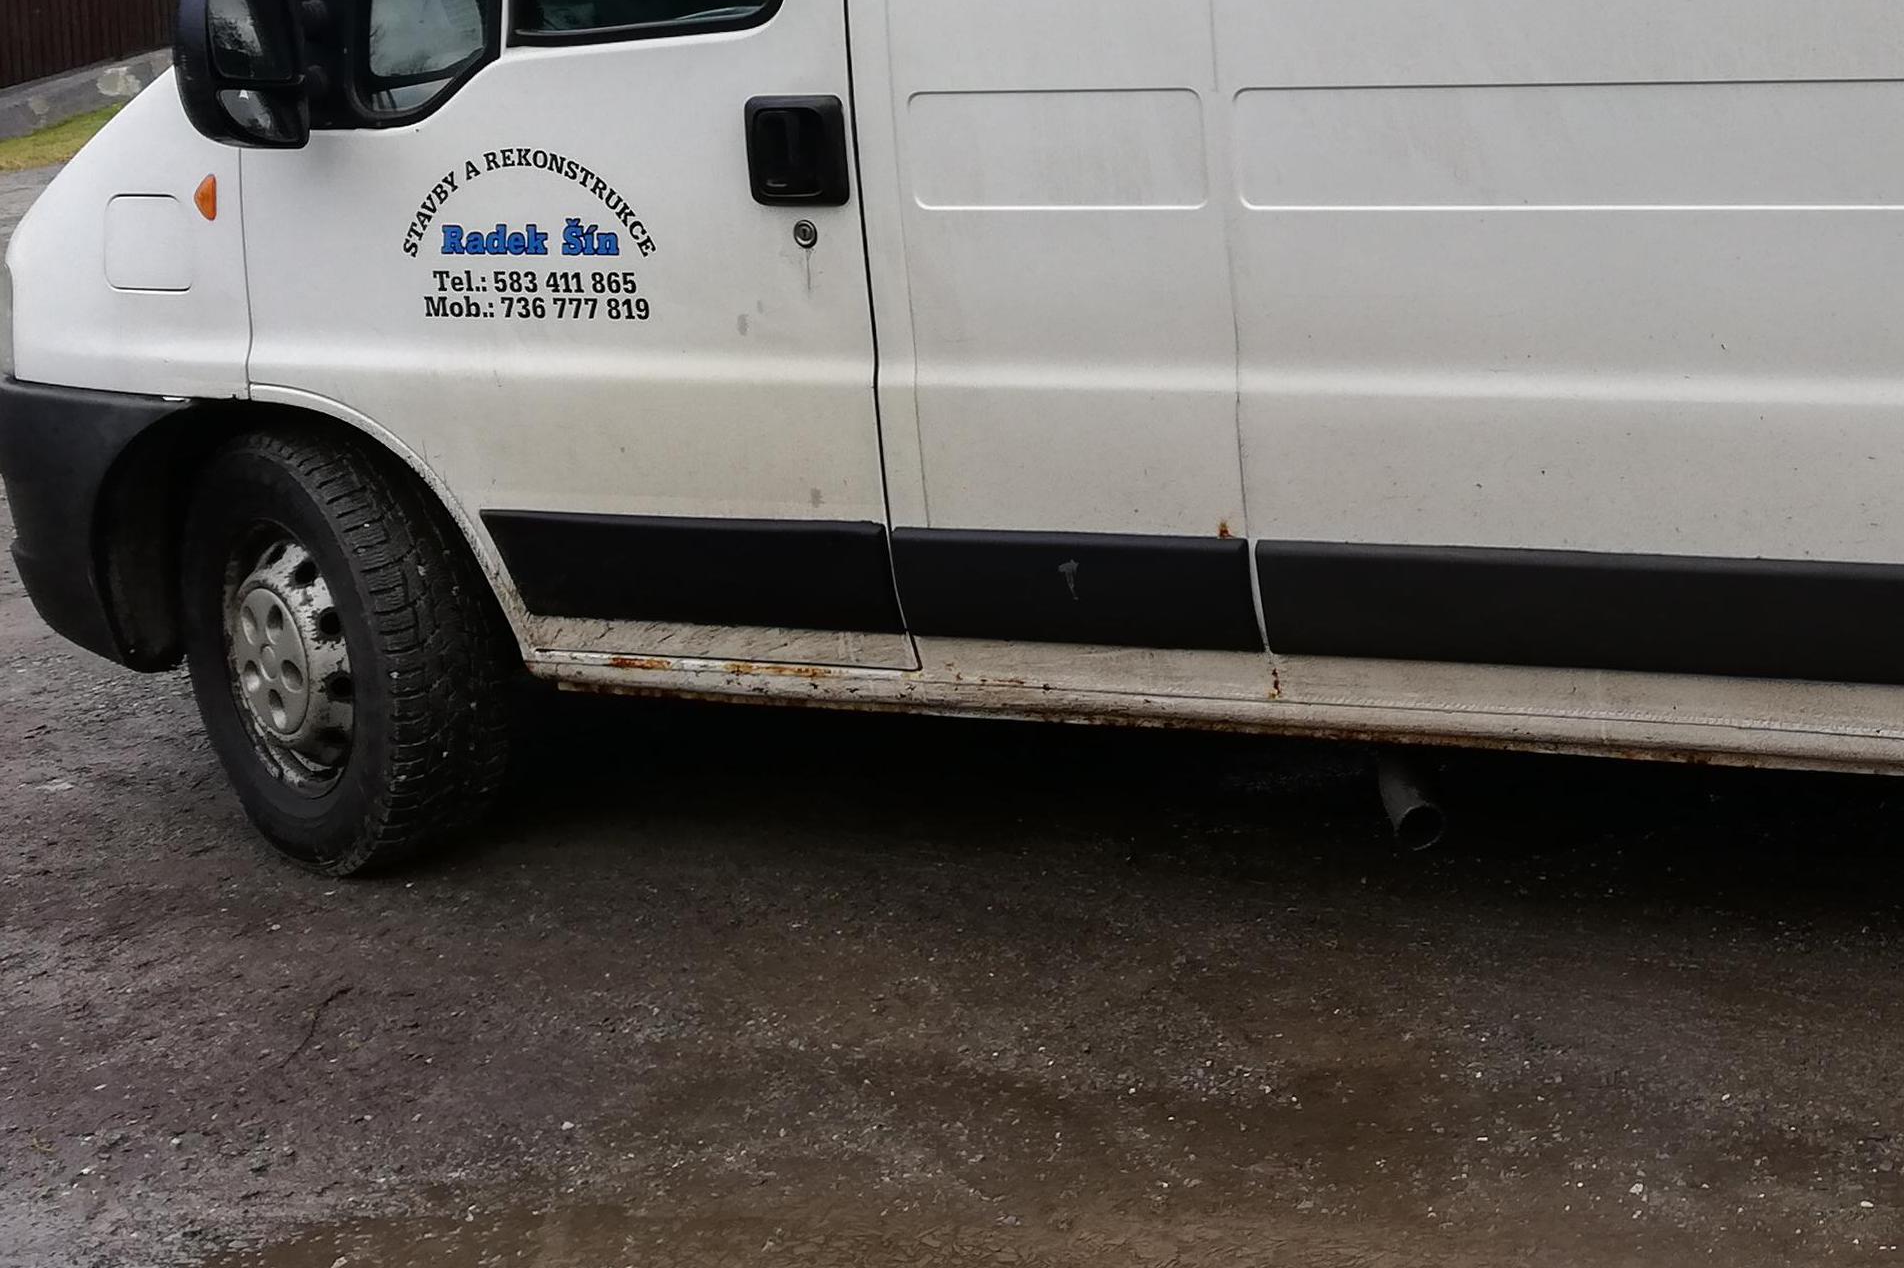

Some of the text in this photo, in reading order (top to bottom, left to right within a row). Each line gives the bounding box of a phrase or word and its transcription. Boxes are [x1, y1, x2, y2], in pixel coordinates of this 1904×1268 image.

[402, 148, 657, 259] STAVBY A REKONSTRUKCE
[440, 217, 620, 256] Radek Šín
[432, 269, 637, 295] Tel.: 583 411 865
[423, 295, 651, 321] Mob.: 736 777 819
